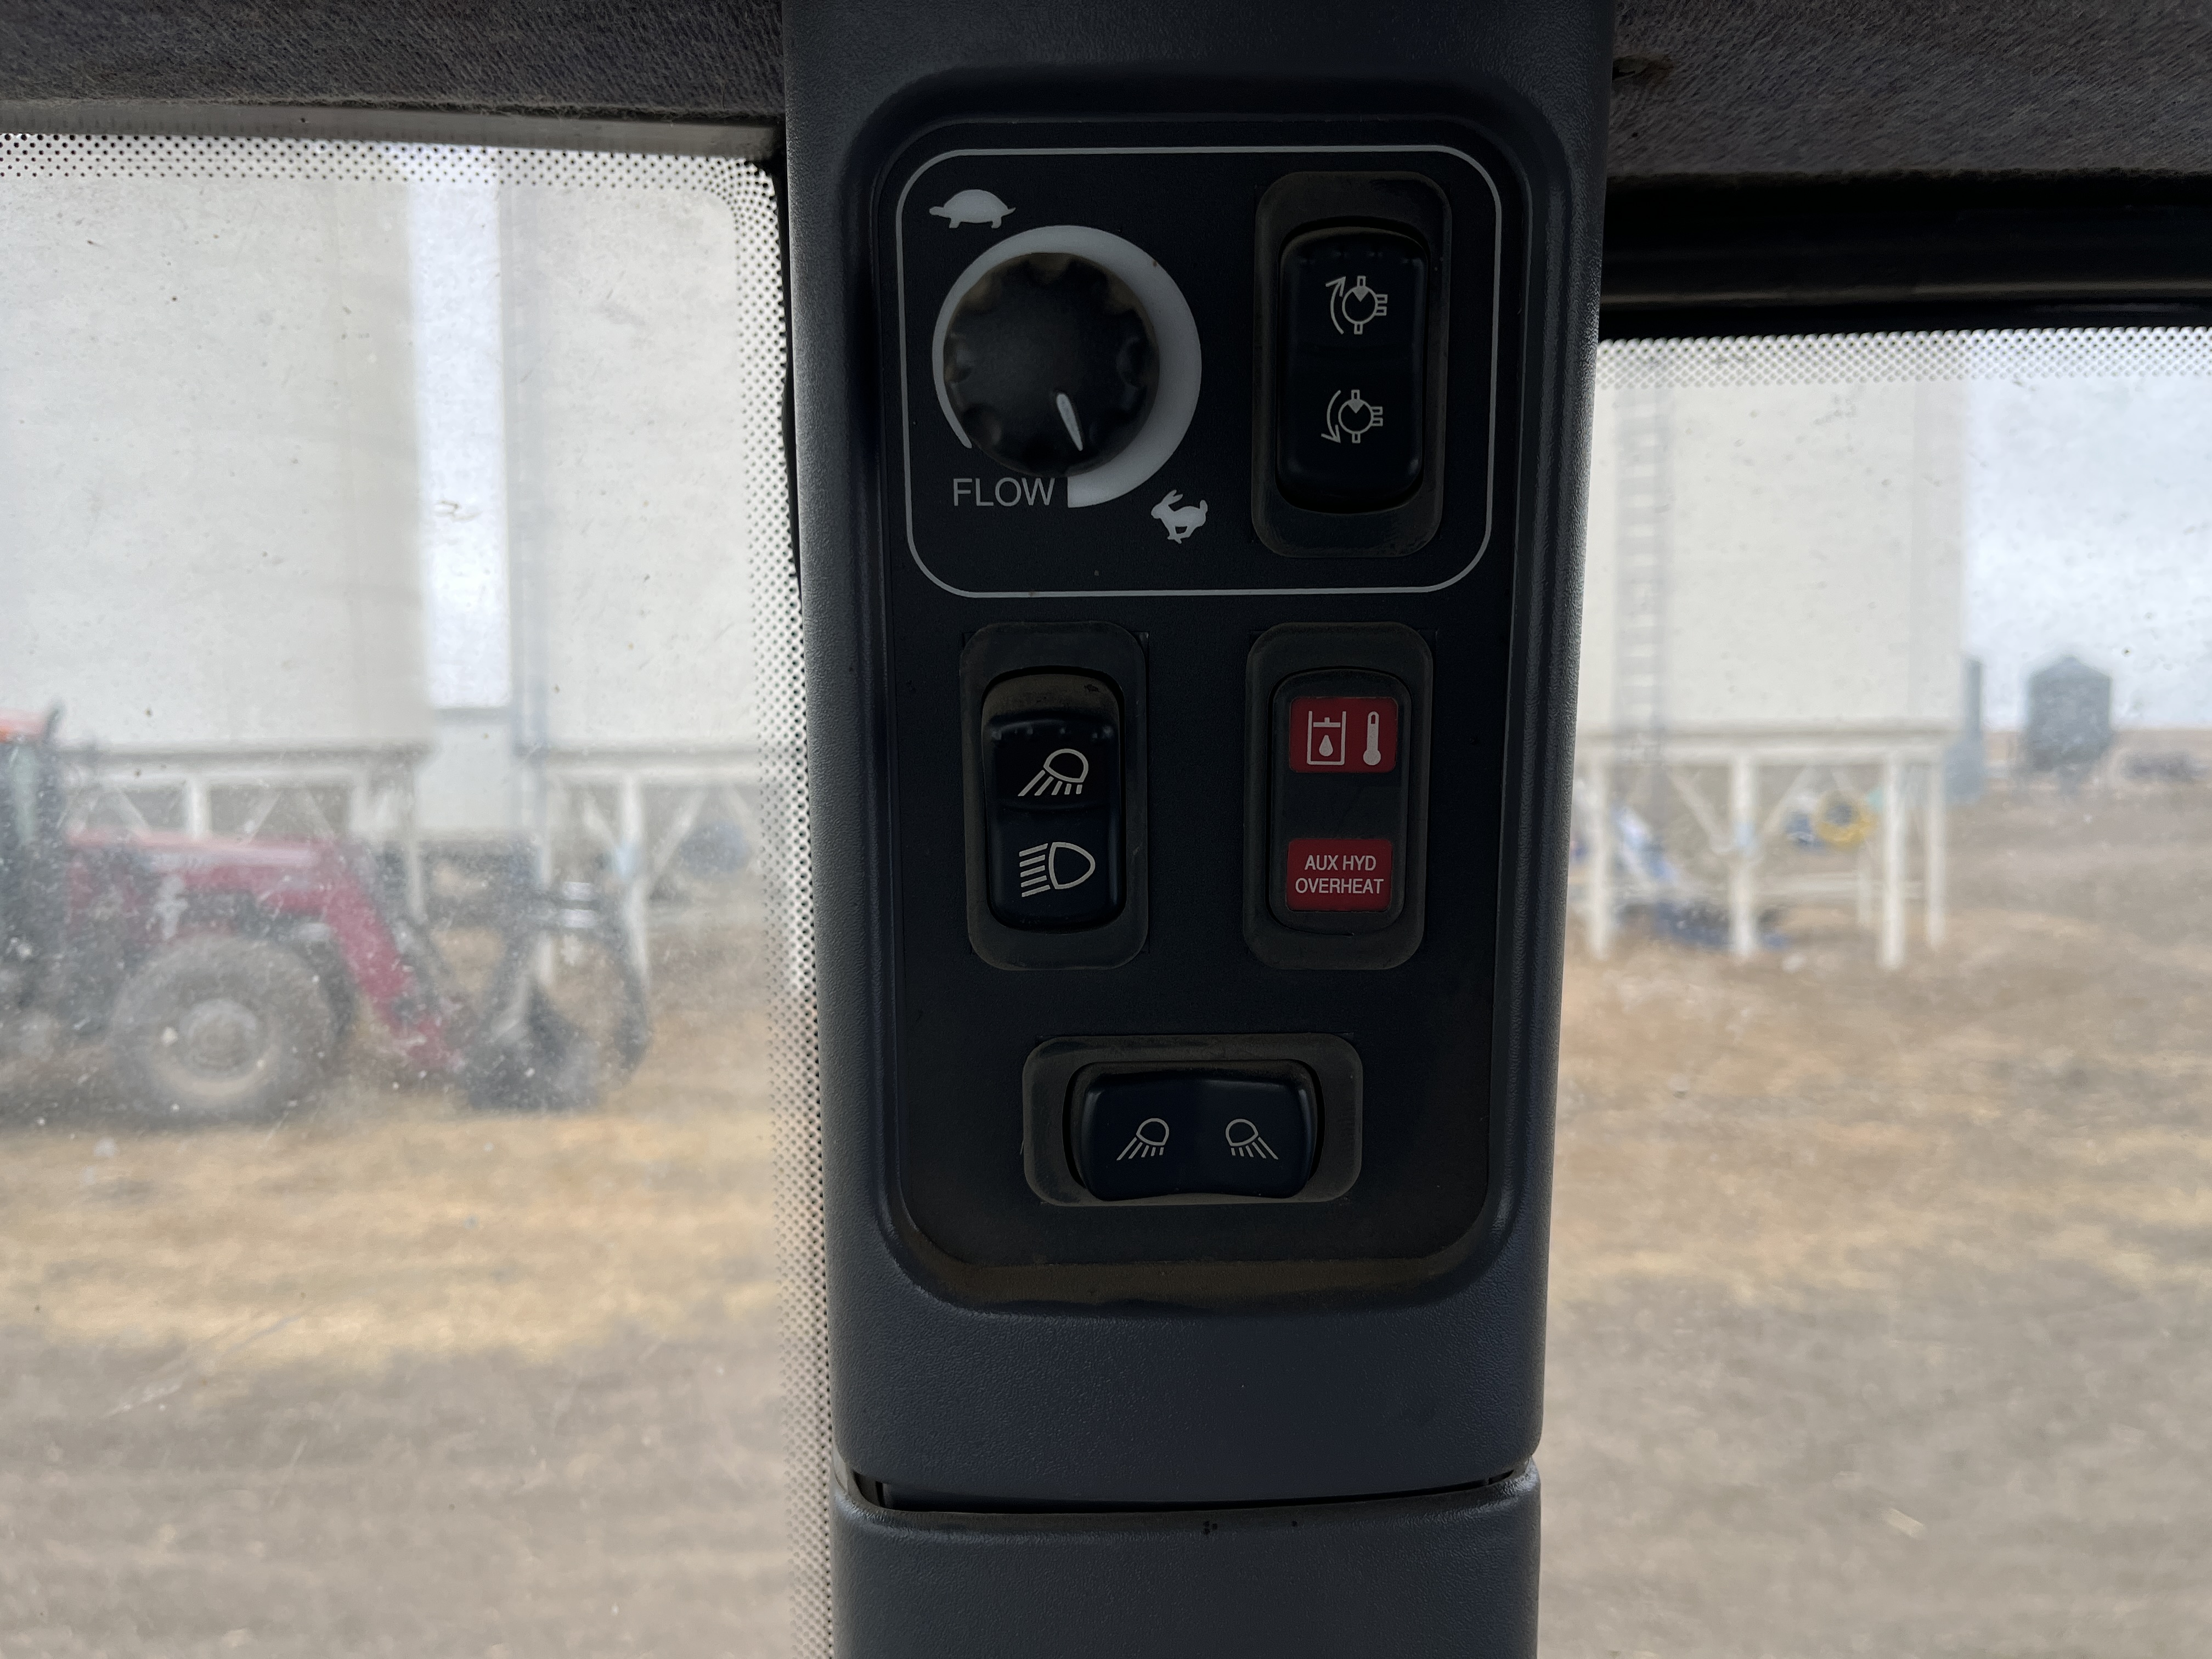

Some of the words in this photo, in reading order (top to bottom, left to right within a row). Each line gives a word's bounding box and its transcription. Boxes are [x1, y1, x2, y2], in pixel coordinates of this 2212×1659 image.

[953, 477, 1056, 507] FLOW
[1305, 854, 1338, 871] AUX
[1342, 854, 1376, 871] HYD
[1295, 877, 1384, 894] OVERHEAT
